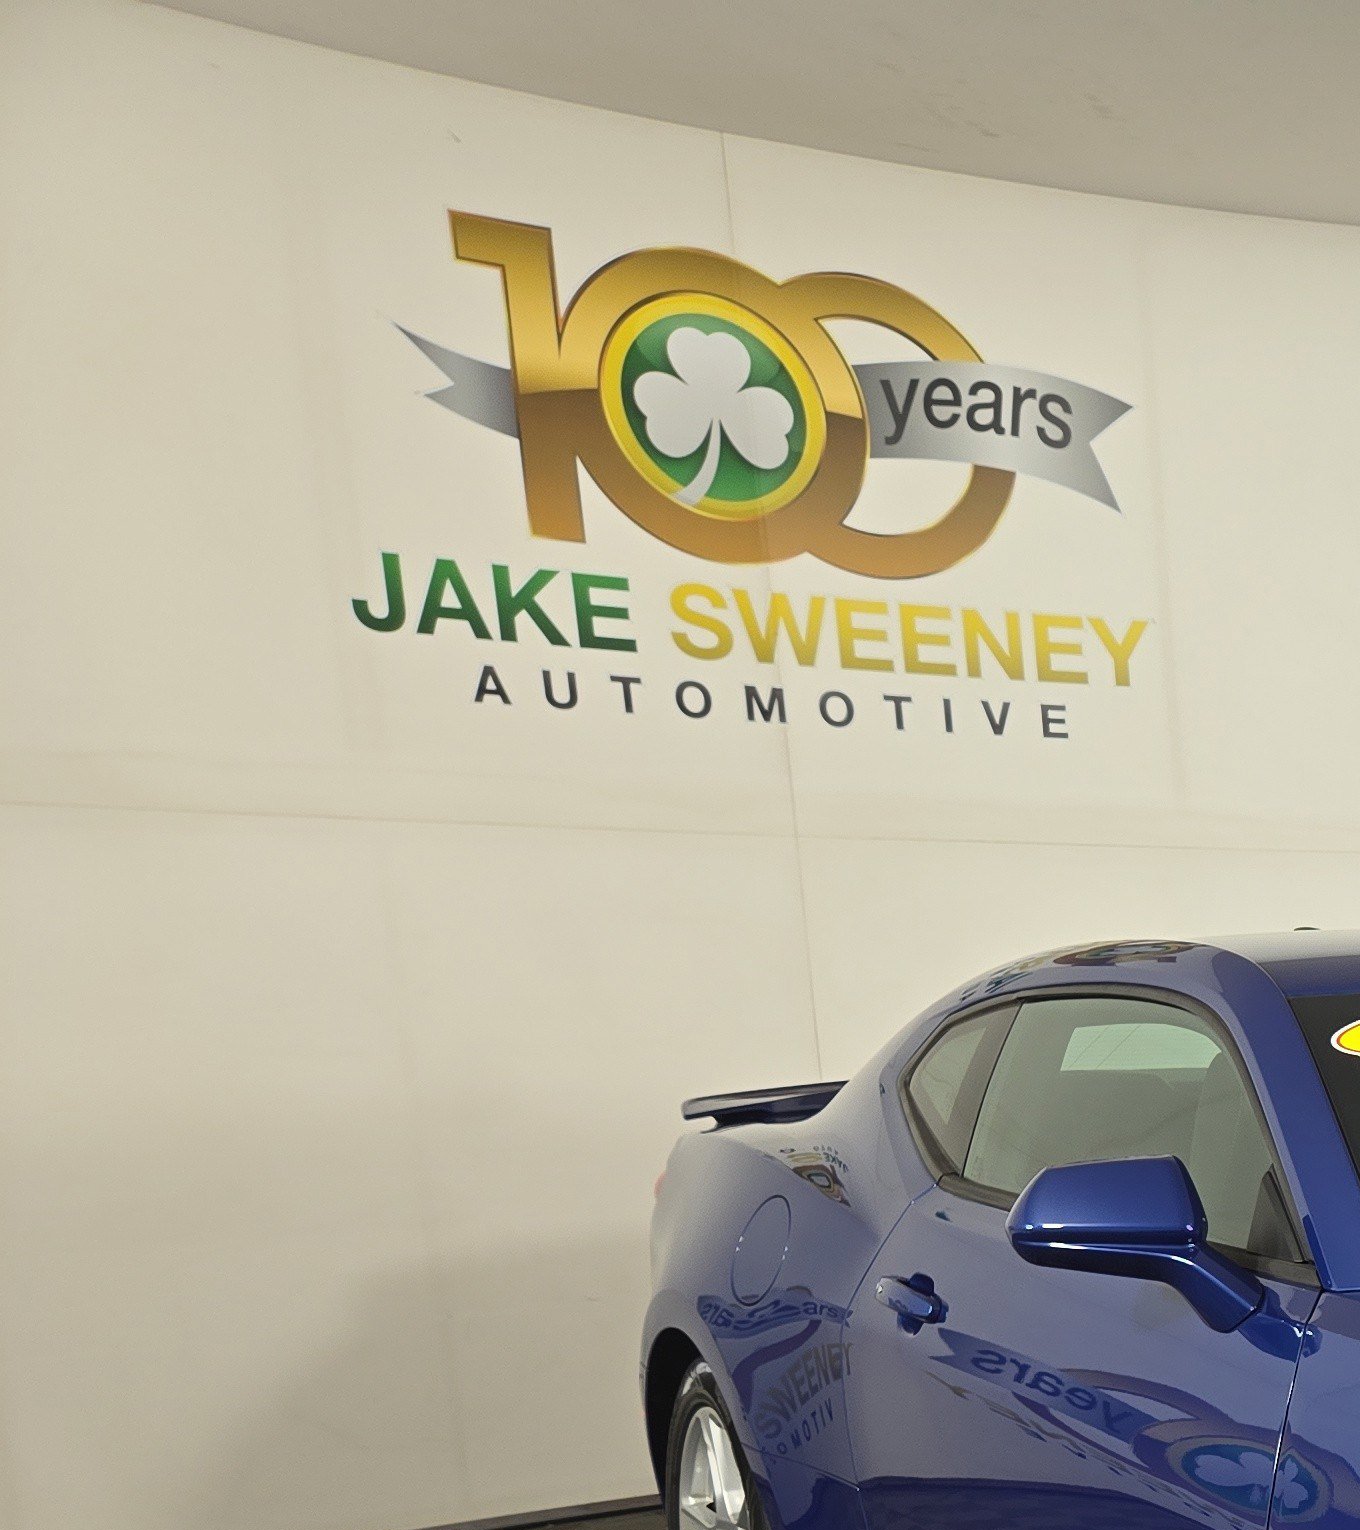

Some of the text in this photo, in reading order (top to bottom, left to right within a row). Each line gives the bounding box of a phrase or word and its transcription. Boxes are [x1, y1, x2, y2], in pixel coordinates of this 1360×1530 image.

[446, 209, 1018, 580] 100
[879, 375, 1075, 450] years
[351, 551, 1148, 688] JAKE SWEENEY
[474, 664, 1070, 739] AUTOMOTIVE
